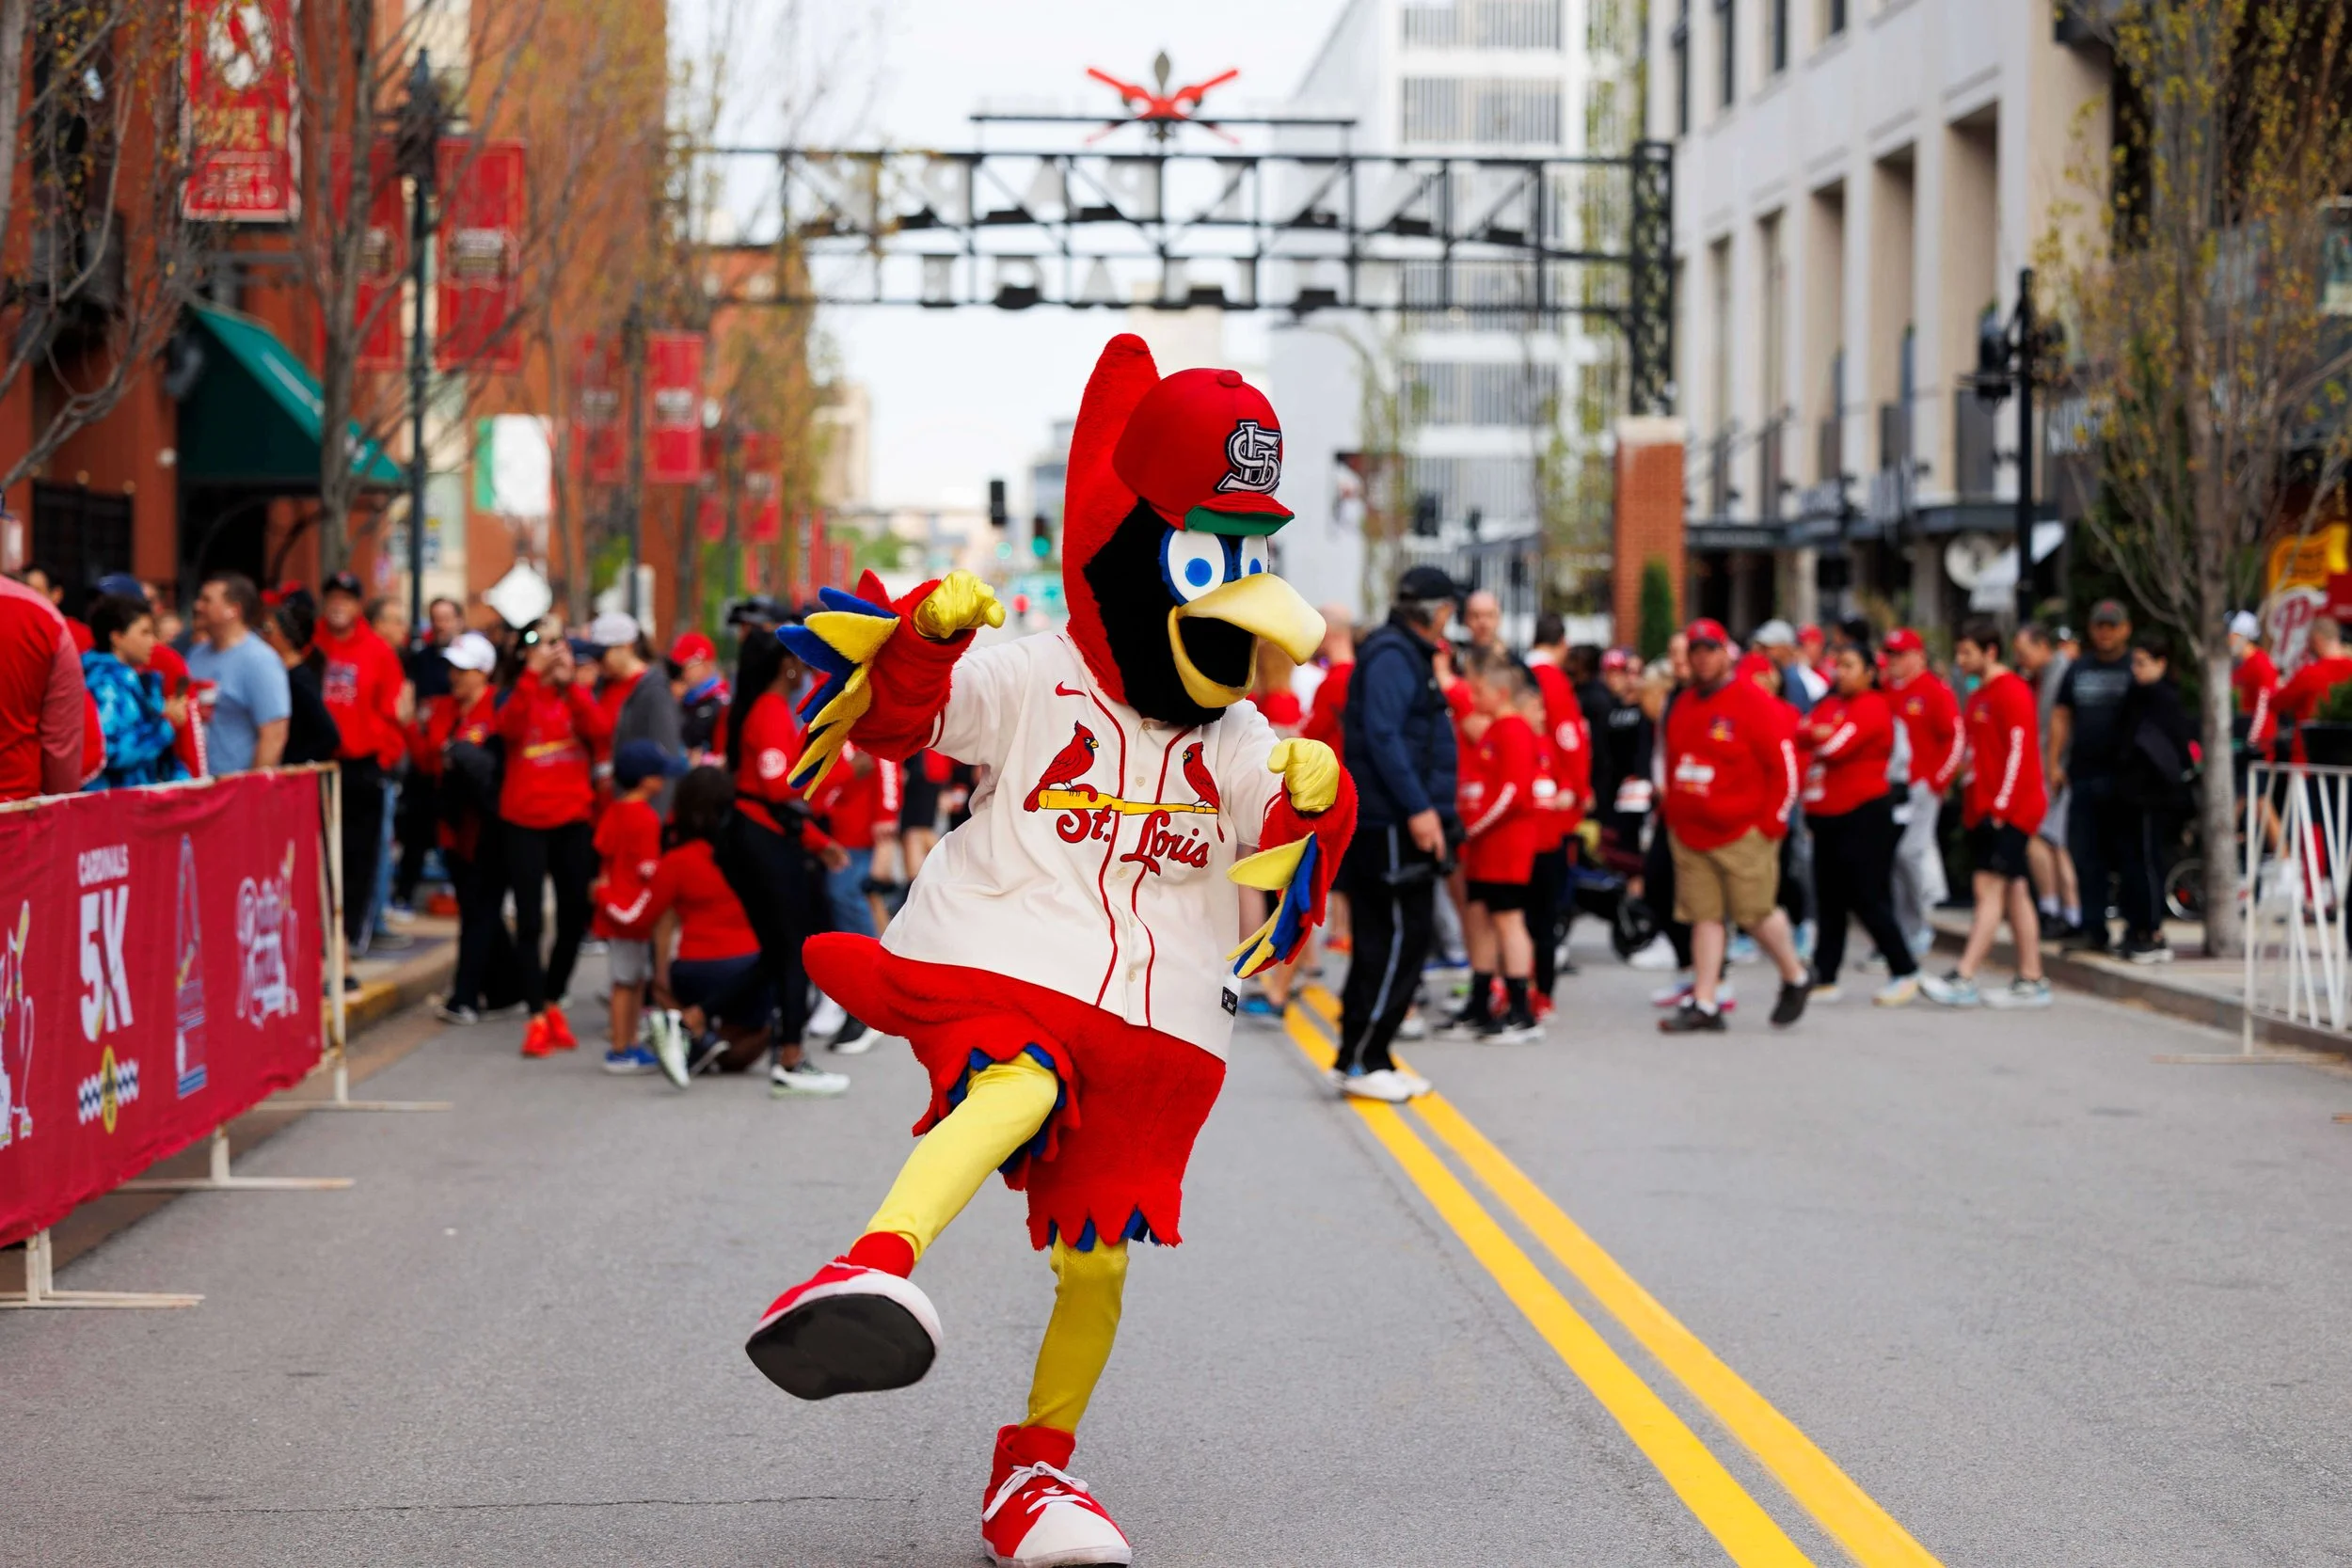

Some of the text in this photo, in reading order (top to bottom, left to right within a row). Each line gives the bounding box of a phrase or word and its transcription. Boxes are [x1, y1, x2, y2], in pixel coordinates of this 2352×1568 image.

[78, 844, 129, 887] CARDINALS
[1056, 784, 1210, 876] St. Louis
[80, 884, 133, 1042] 5K
